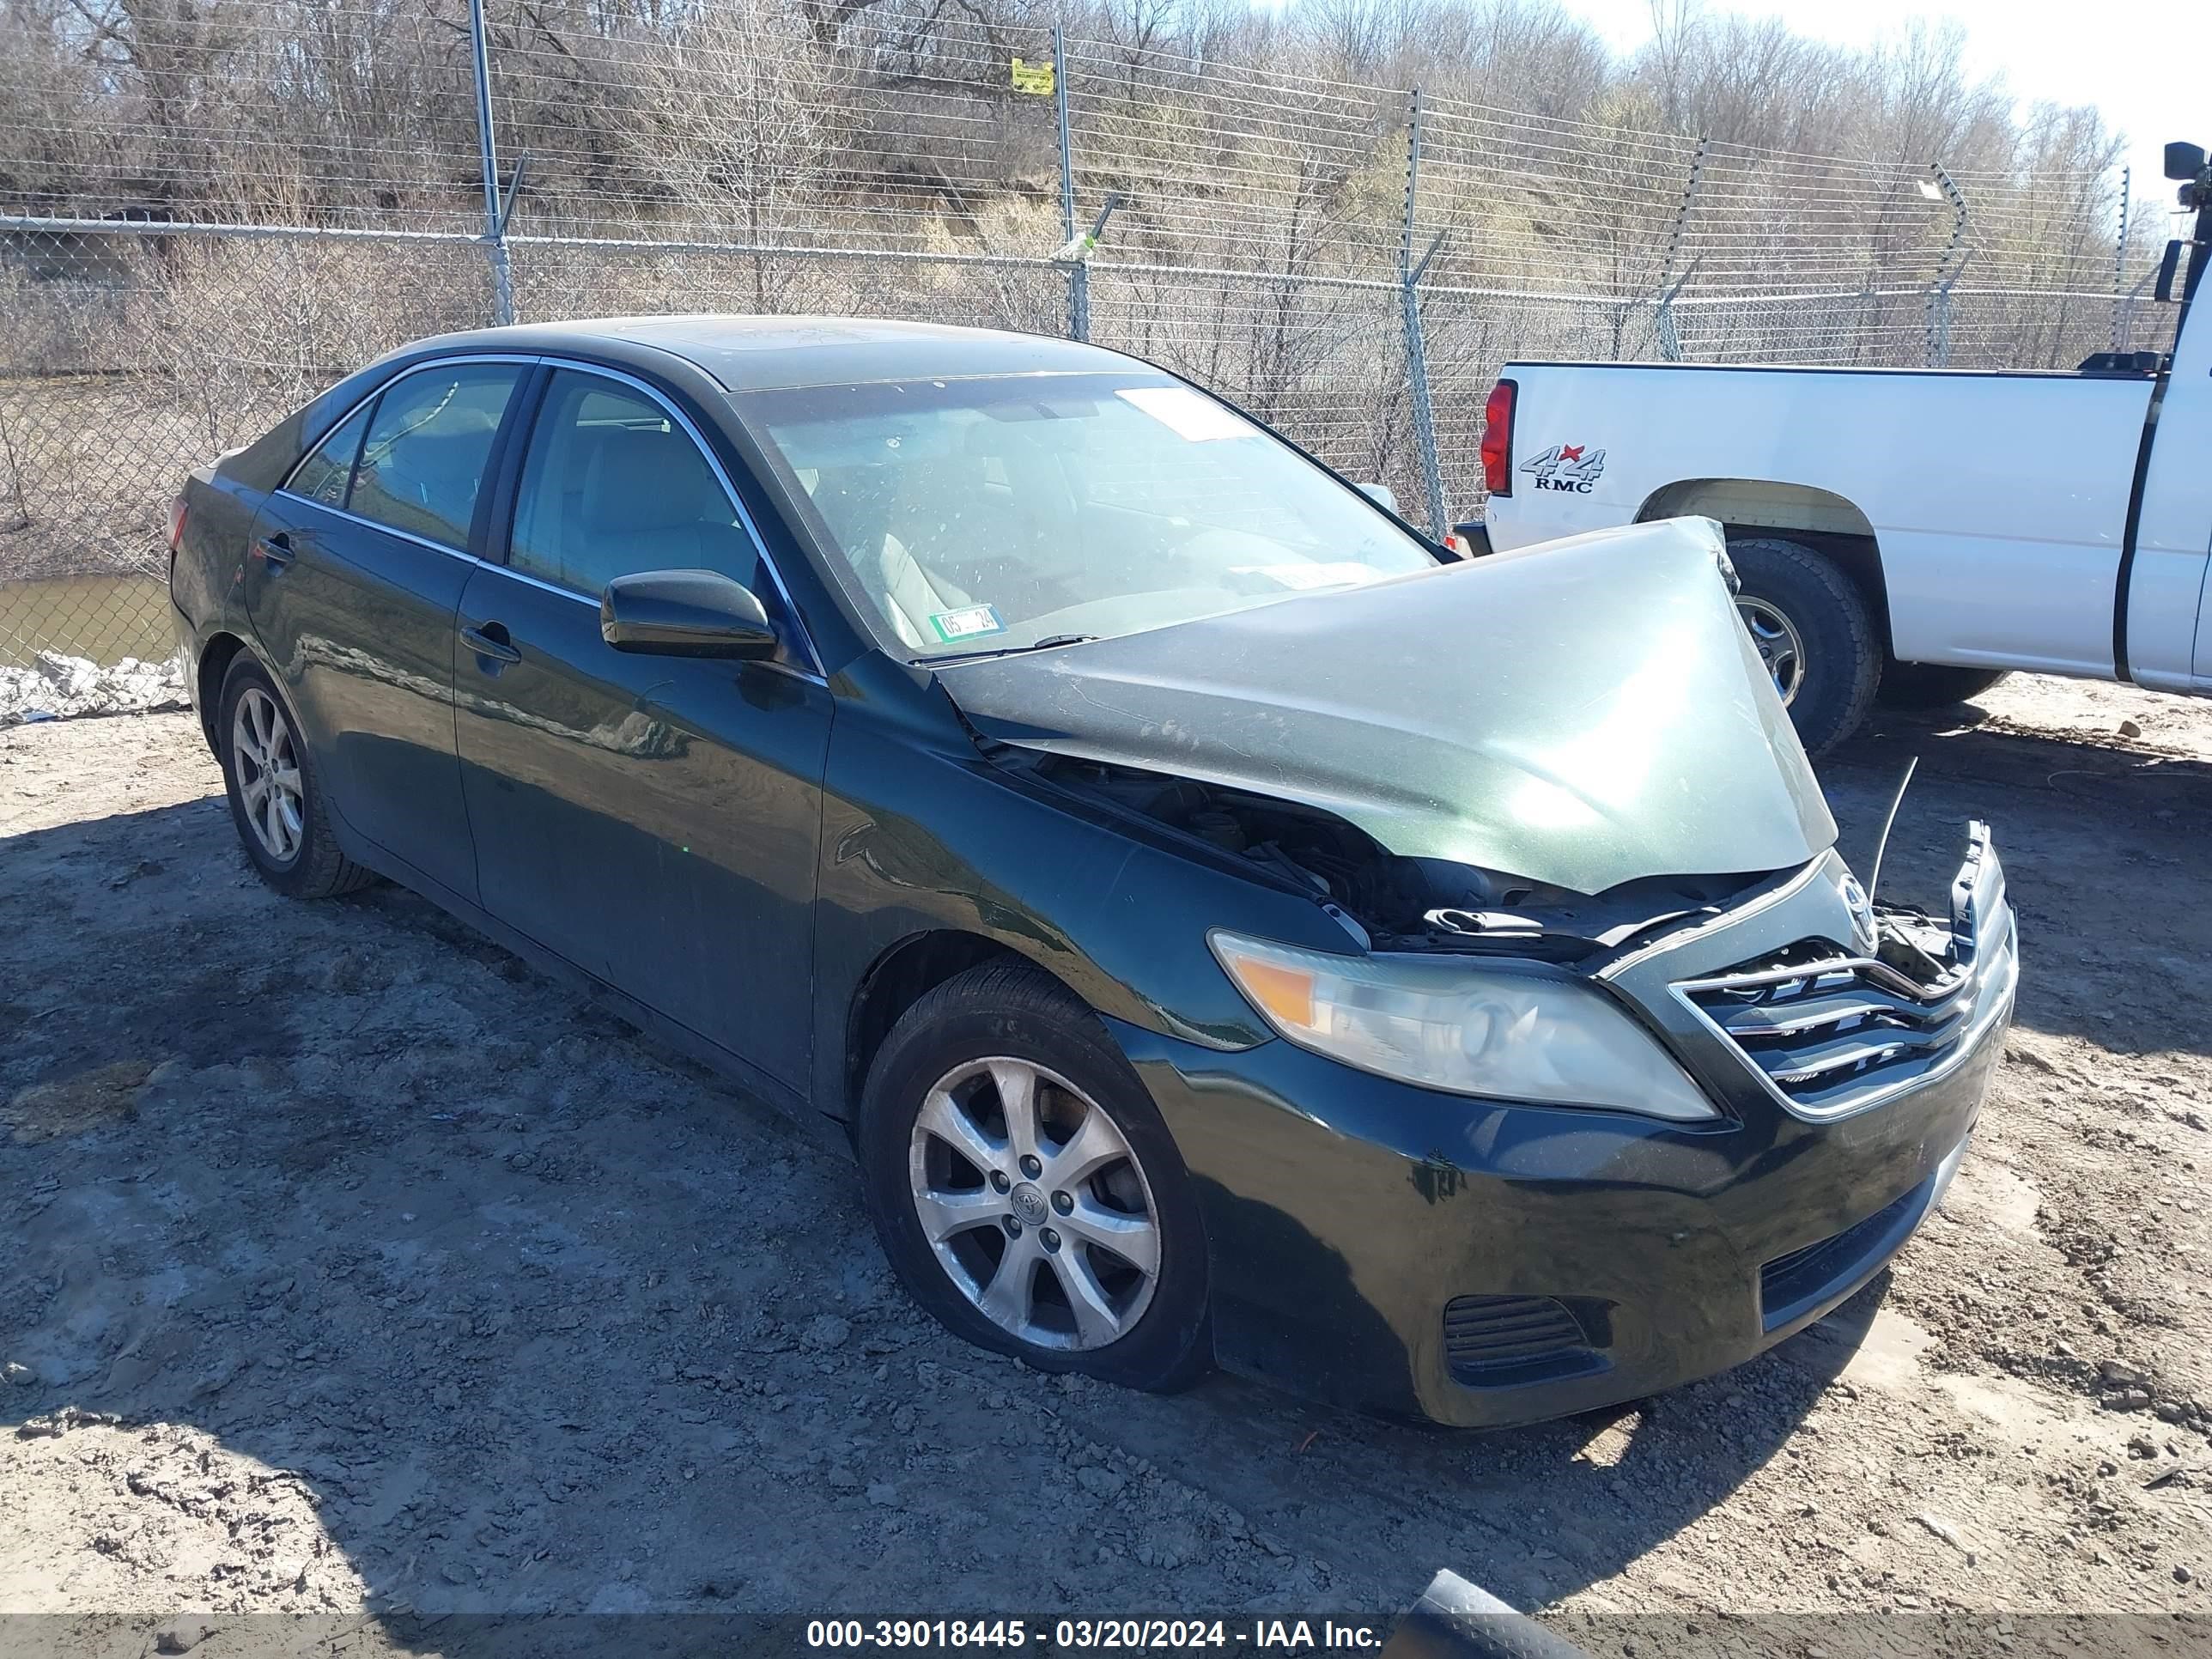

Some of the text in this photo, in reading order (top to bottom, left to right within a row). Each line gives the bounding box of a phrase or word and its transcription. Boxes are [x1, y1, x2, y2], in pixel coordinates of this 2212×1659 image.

[1534, 477, 1593, 494] RMC
[942, 609, 995, 635] 05 24
